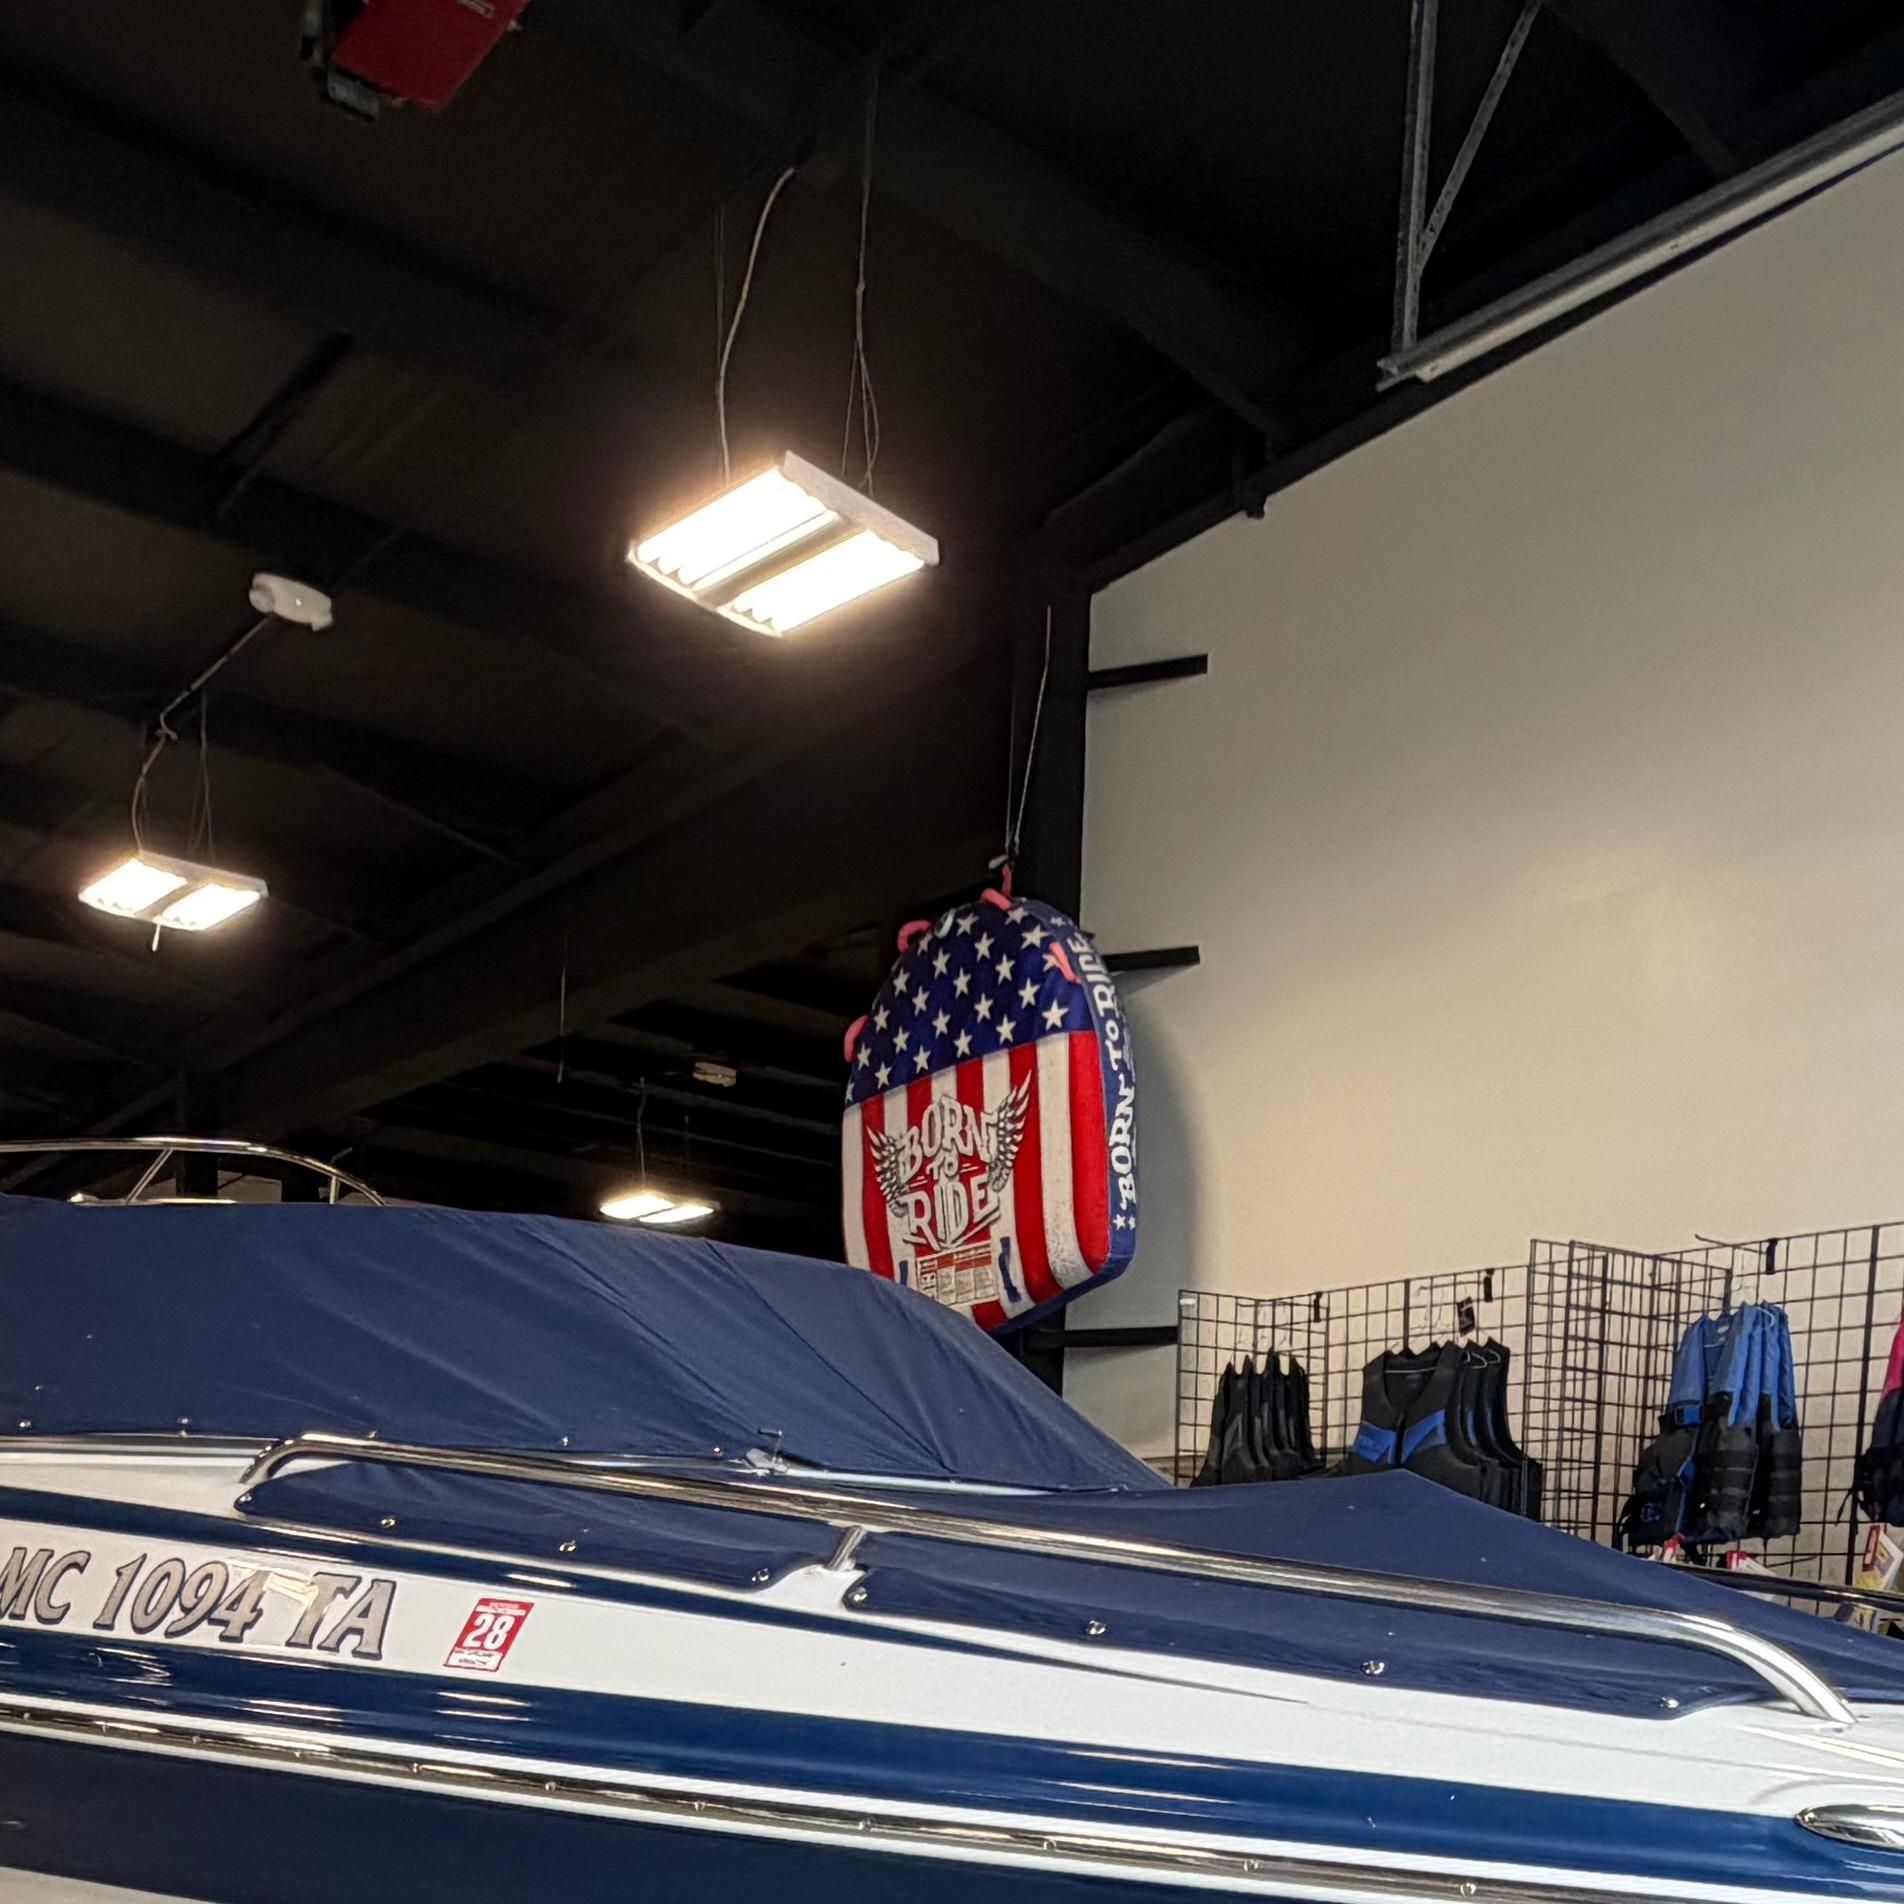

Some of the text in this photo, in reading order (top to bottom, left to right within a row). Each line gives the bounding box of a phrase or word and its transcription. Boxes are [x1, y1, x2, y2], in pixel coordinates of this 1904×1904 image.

[895, 1094, 998, 1183] BORN
[926, 1149, 959, 1179] TO
[1108, 1074, 1136, 1211] BORN
[897, 1173, 1000, 1250] RIDE
[93, 1553, 270, 1643] 1094
[285, 1572, 396, 1660] TA
[462, 1613, 516, 1650] 28
